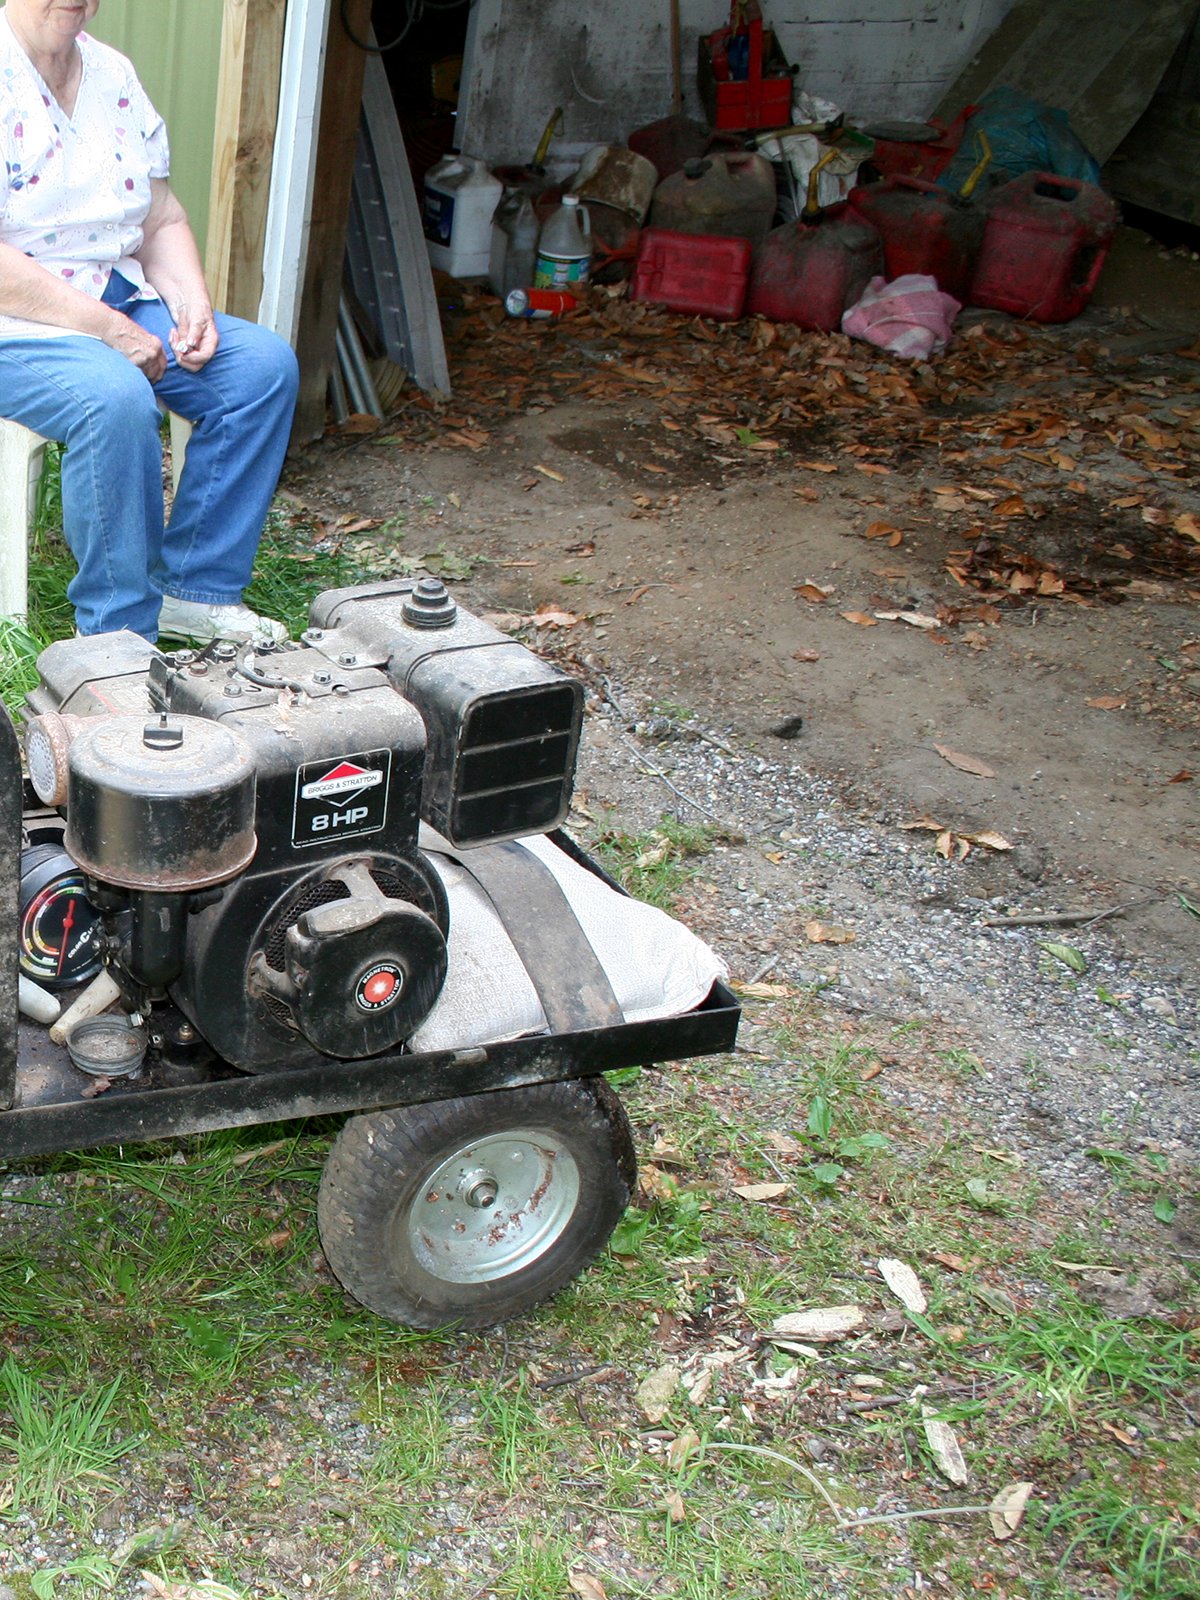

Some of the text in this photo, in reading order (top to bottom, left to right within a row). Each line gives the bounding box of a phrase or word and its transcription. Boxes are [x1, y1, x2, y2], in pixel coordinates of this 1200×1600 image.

[308, 782, 335, 795] BRIGGS
[342, 775, 378, 788] STRATTON
[311, 806, 369, 832] 8 HP
[362, 966, 395, 984] MAGNETRON
[358, 993, 372, 1008] BRIGGS
[380, 979, 400, 1006] STRATTON
